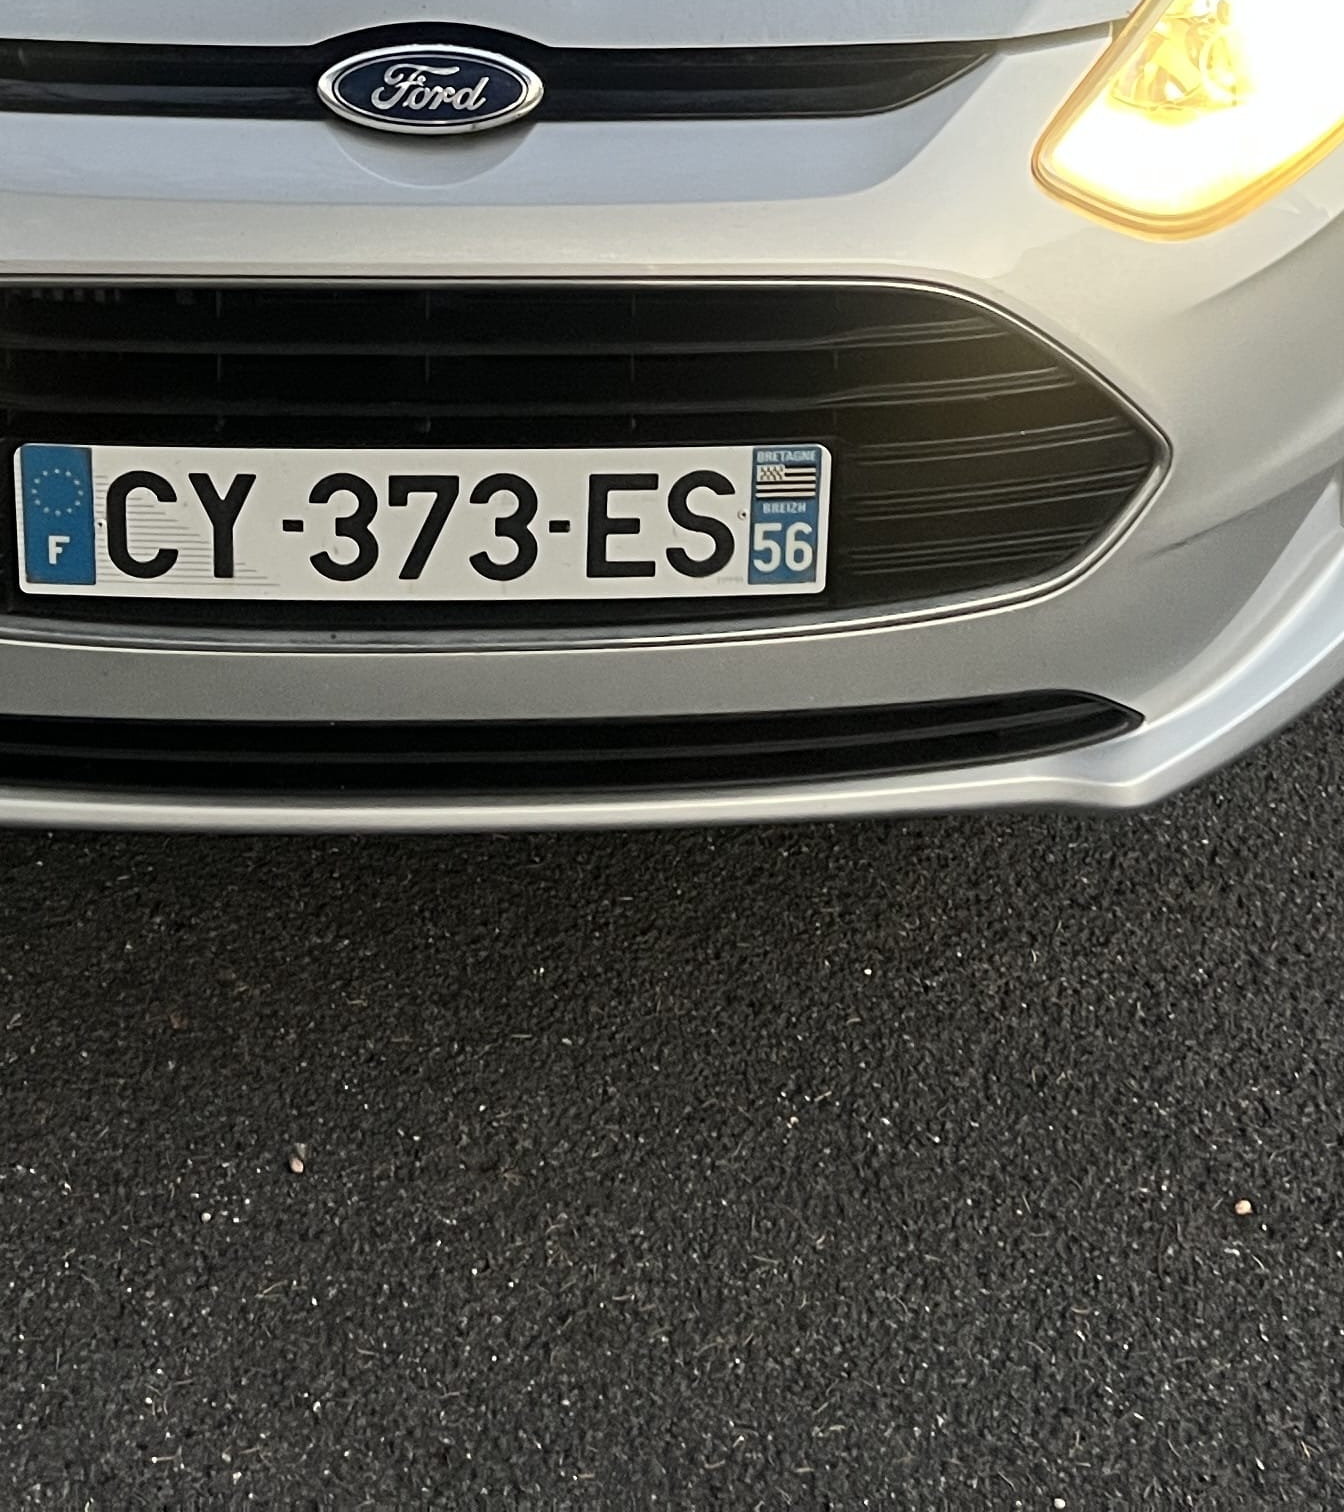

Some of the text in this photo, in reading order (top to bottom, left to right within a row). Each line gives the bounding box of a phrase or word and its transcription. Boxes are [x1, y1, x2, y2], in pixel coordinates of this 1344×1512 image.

[370, 63, 491, 111] Ford
[757, 450, 816, 463] BRETAGNE
[106, 469, 736, 582] CY-373-ES
[762, 502, 806, 513] BREIZH
[48, 535, 71, 565] F
[753, 521, 813, 573] 56
